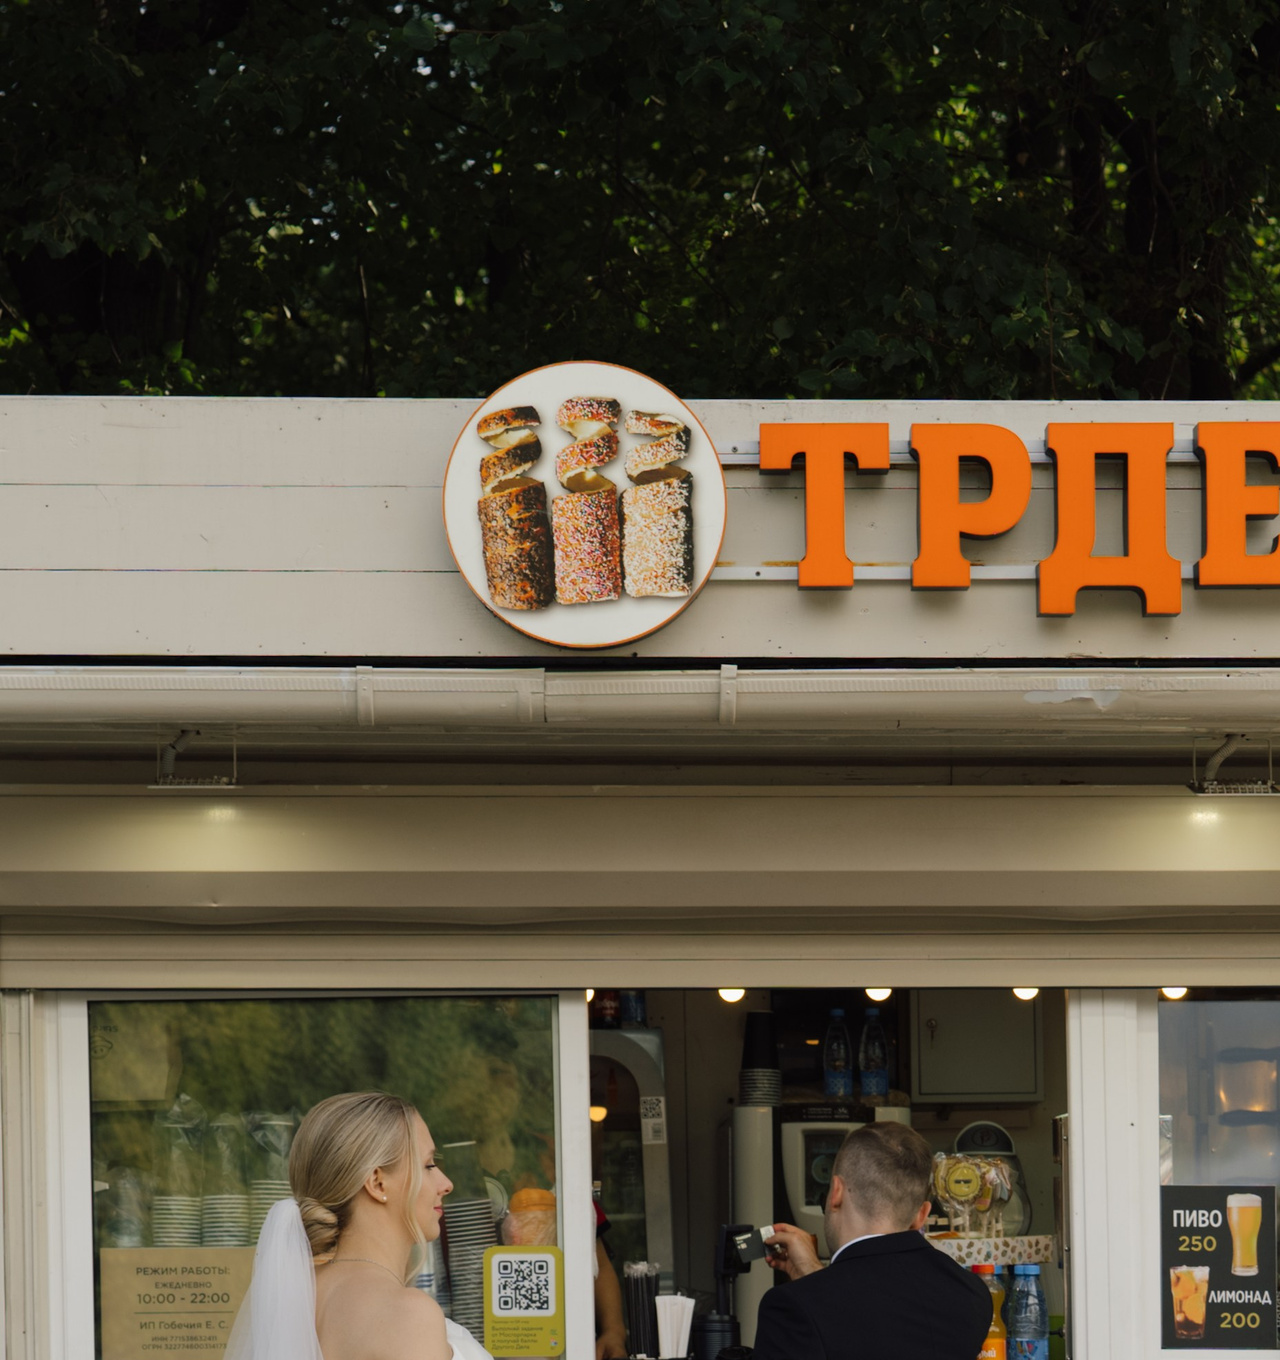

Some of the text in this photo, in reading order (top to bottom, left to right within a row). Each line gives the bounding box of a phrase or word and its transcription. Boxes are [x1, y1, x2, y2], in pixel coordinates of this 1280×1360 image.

[1173, 1210, 1222, 1227] ПИВО
[1178, 1236, 1217, 1252] 250
[136, 1266, 230, 1276] РЕЖИМ РАБОТЫ:
[154, 1281, 212, 1290] ЕЖЕДНЕВНО
[137, 1293, 176, 1304] 10:00
[190, 1292, 230, 1304] 22:00
[1208, 1290, 1272, 1305] ЛИМОНАД
[140, 1321, 155, 1330] ИП
[205, 1321, 215, 1329] Е.
[1220, 1312, 1260, 1328] 200
